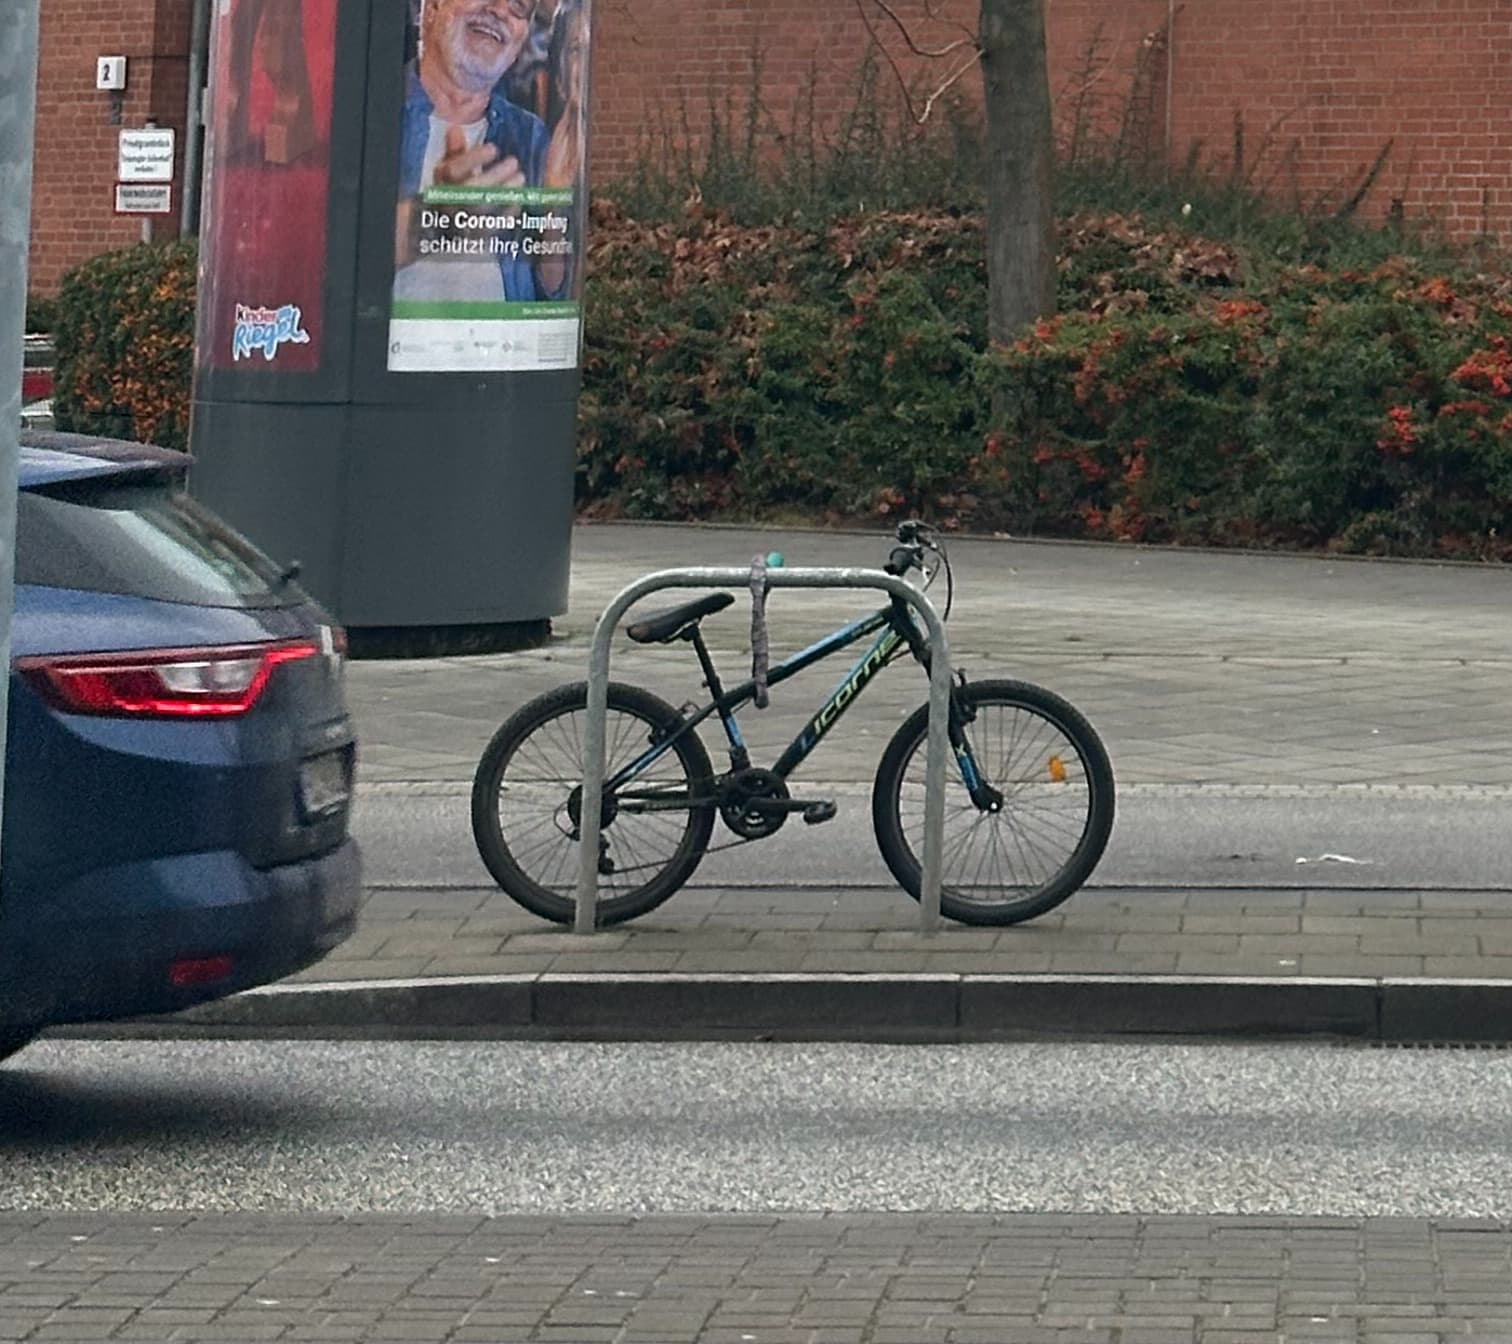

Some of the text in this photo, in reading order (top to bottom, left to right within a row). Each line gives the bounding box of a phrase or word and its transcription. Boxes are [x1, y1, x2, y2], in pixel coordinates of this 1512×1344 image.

[103, 64, 110, 81] 2
[421, 211, 450, 229] Die
[419, 235, 485, 255] schützt
[489, 236, 519, 255] Ihre
[232, 303, 310, 362] Riegel
